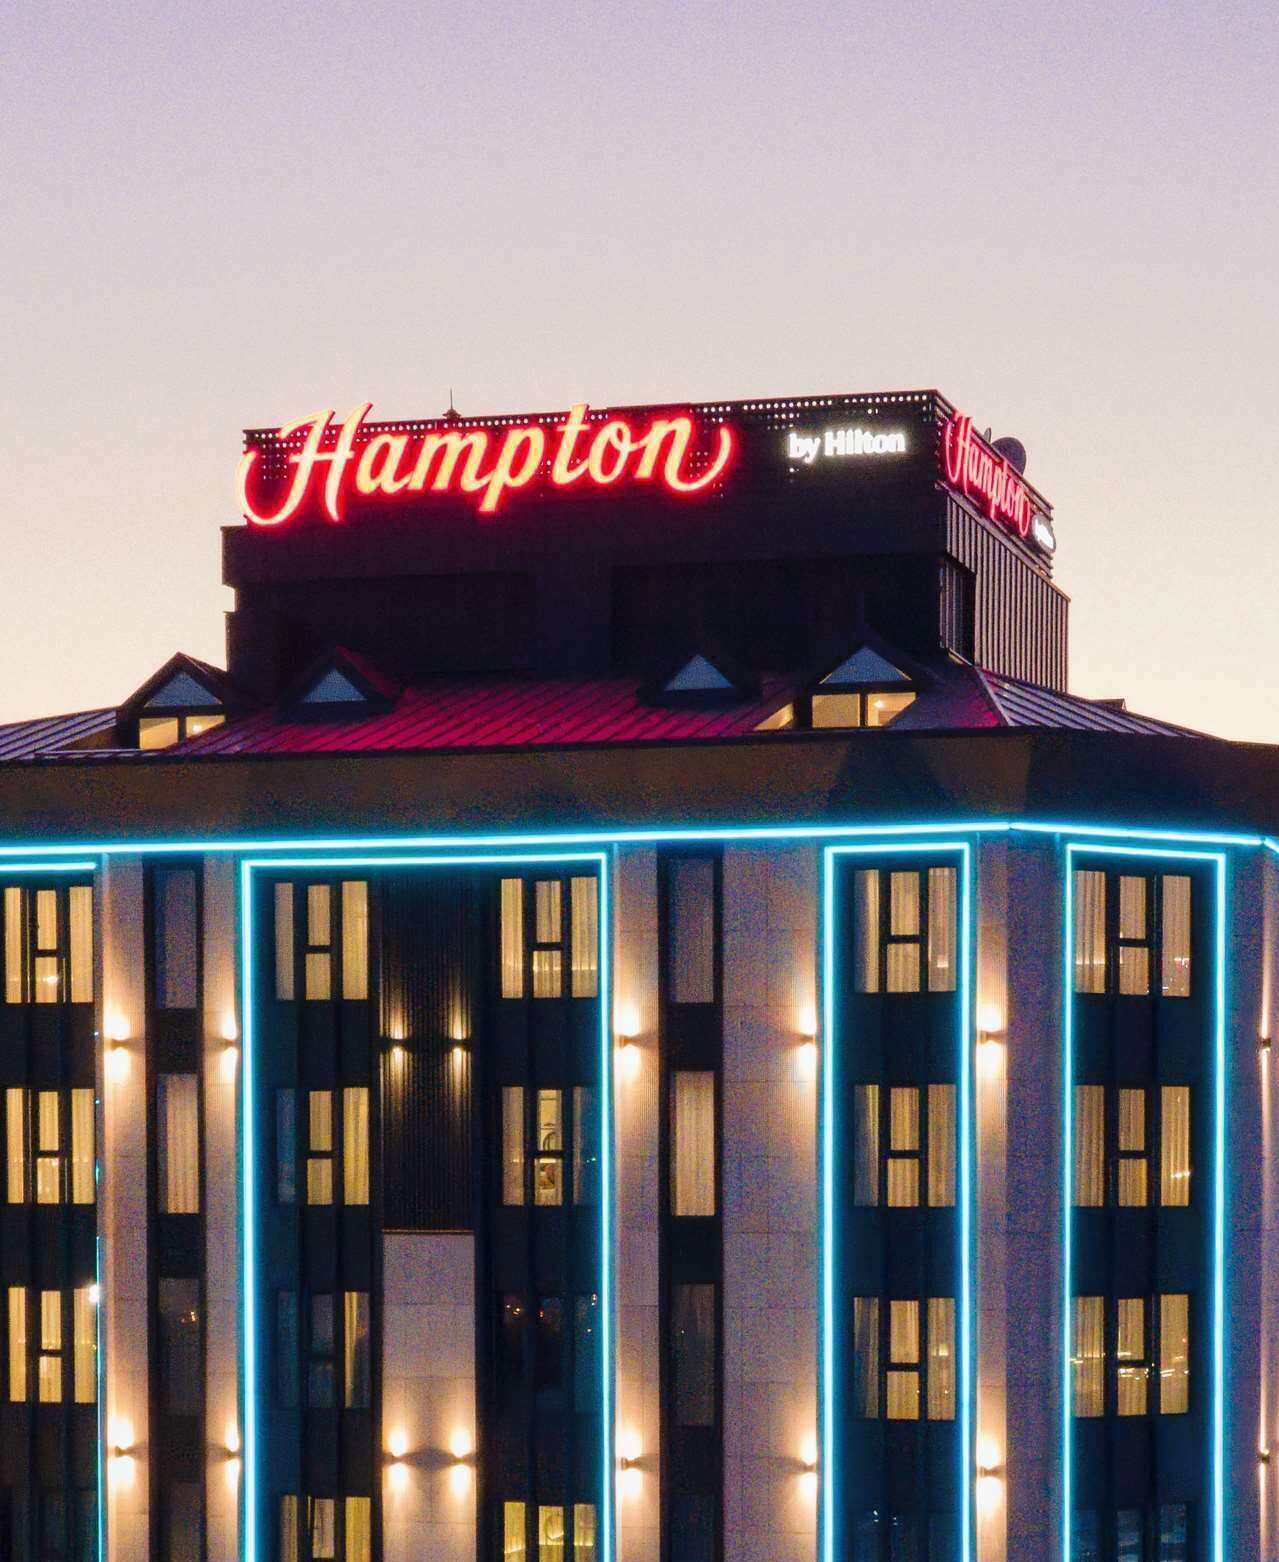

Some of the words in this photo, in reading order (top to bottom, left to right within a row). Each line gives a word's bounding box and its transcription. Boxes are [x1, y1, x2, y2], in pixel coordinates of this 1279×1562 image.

[237, 402, 731, 526] Hampton
[787, 432, 821, 464] by
[824, 427, 906, 457] Hilton
[945, 411, 1031, 537] Hampton
